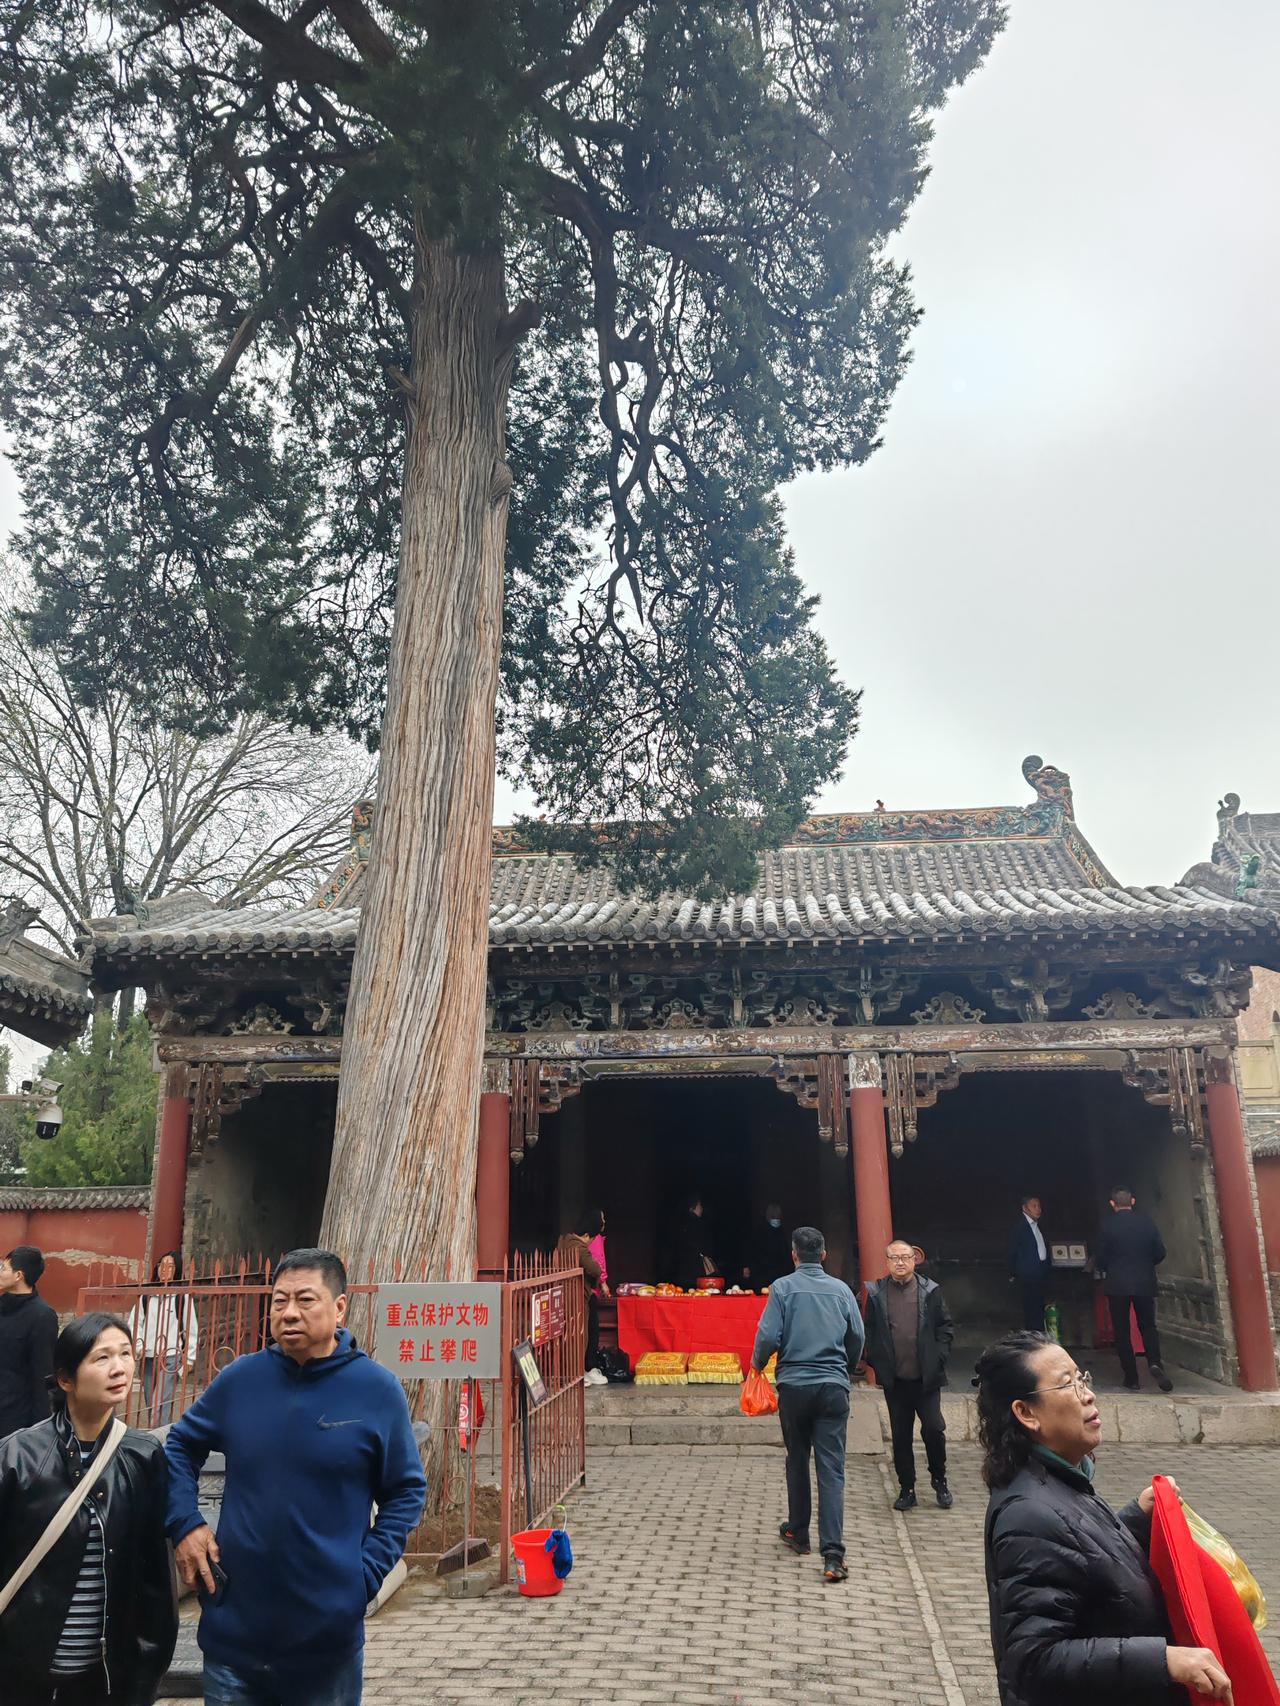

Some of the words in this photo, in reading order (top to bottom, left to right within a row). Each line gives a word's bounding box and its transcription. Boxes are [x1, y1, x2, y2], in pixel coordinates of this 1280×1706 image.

[386, 1302, 489, 1327] 重点保护文物
[399, 1338, 478, 1363] 禁止攀爬
